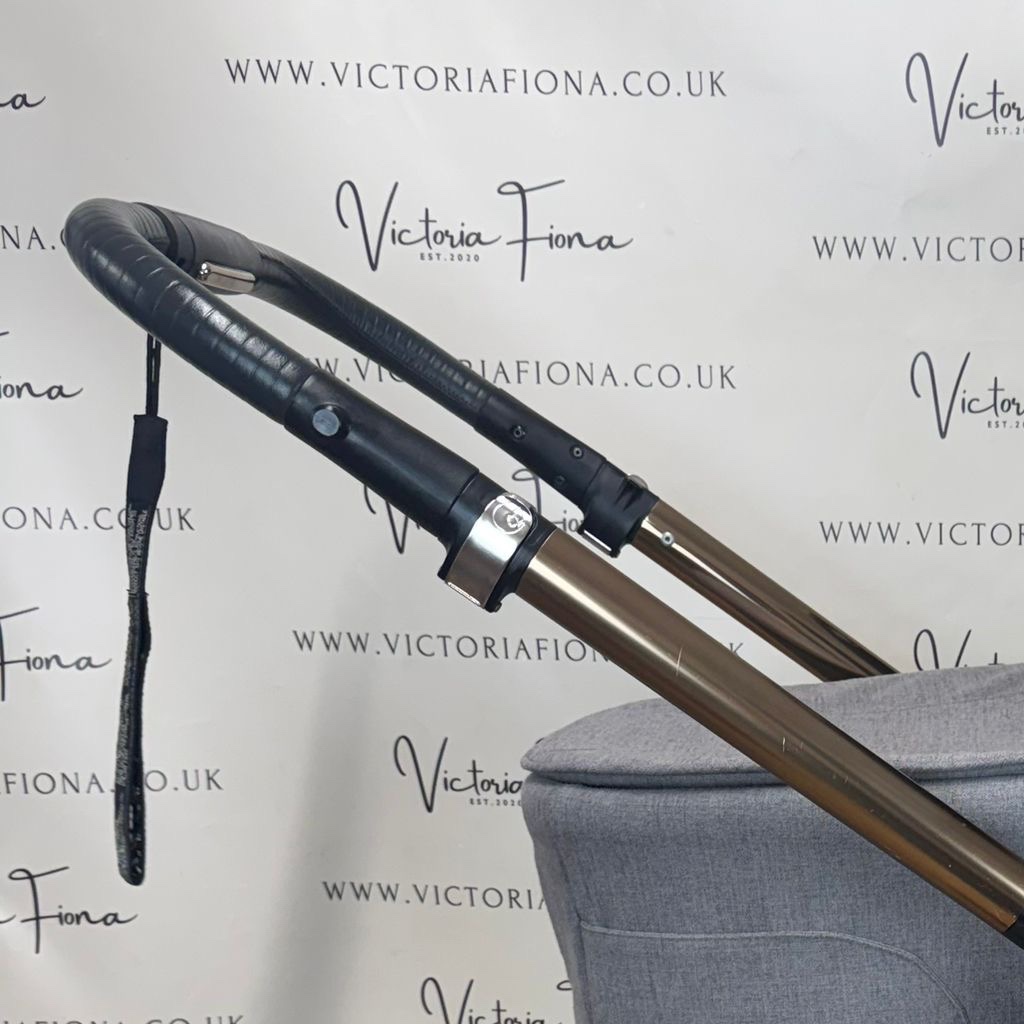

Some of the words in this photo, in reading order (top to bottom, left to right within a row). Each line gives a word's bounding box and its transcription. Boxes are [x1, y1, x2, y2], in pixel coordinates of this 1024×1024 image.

[224, 58, 728, 97] WWW.VICTORIAFIONA.CO.UK
[336, 180, 501, 271] Victoria
[497, 179, 634, 282] Fiona
[419, 252, 481, 262] EST.2020
[394, 735, 524, 813] Victoria
[8, 866, 138, 954] Fiona
